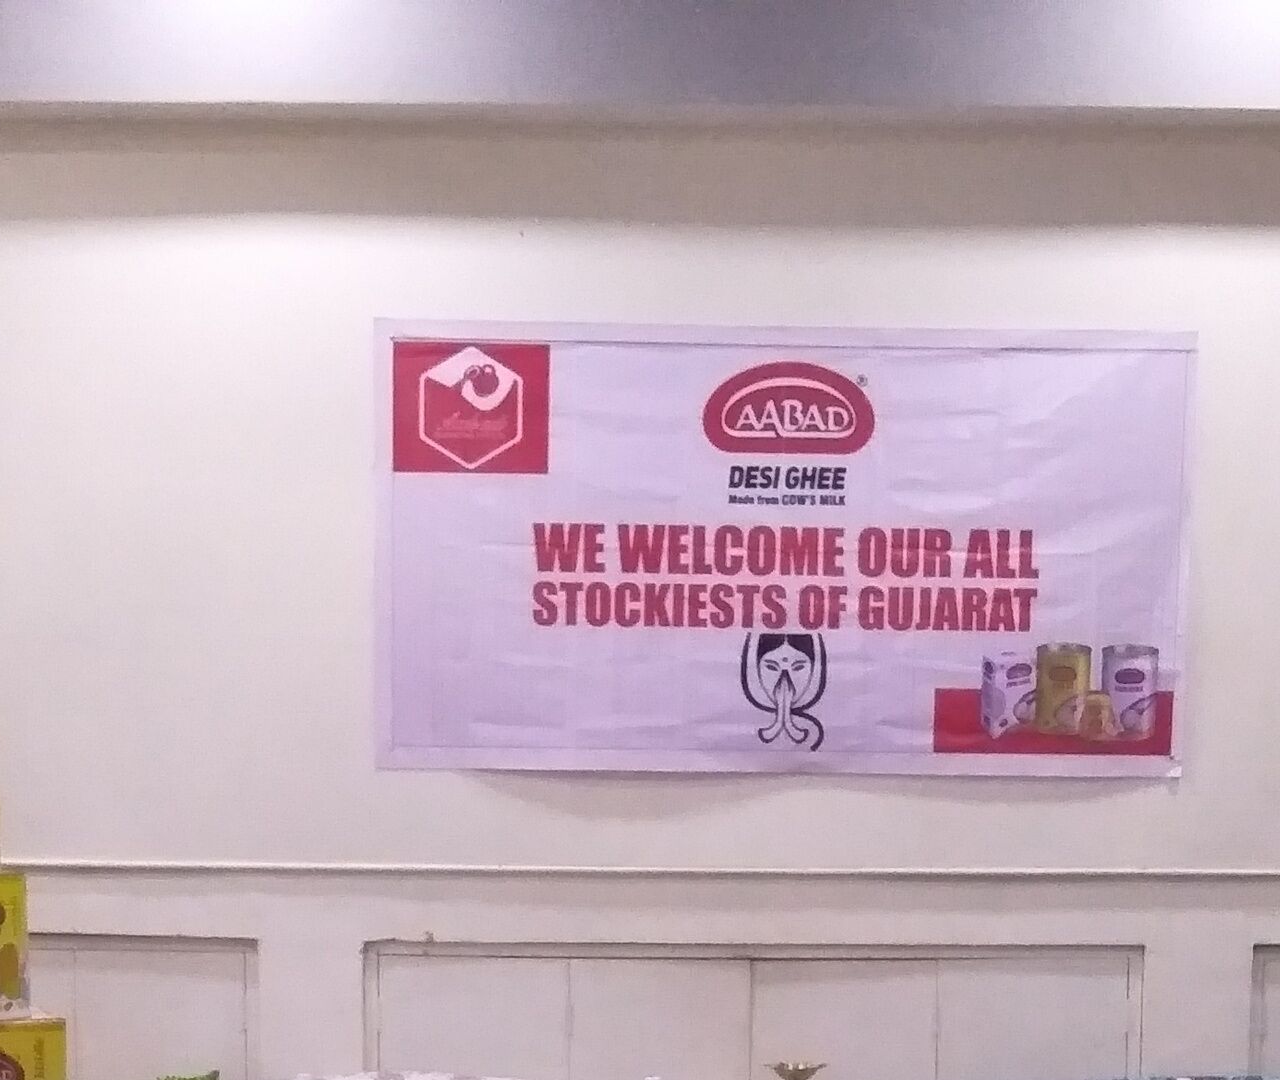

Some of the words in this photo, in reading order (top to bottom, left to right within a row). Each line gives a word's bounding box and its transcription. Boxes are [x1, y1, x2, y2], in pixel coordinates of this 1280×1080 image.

[734, 399, 850, 432] AABAD
[728, 466, 780, 489] DESI
[785, 467, 847, 490] GHEE
[728, 495, 755, 504] Made
[757, 495, 780, 505] from
[819, 495, 846, 505] MILK
[533, 523, 606, 573] WE
[618, 524, 845, 577] WELCOME
[857, 527, 953, 578] OUR
[963, 529, 1040, 579] ALL
[532, 581, 787, 629] STOCKIESTS
[798, 585, 848, 630] OF
[857, 586, 1039, 632] GUJARAT
